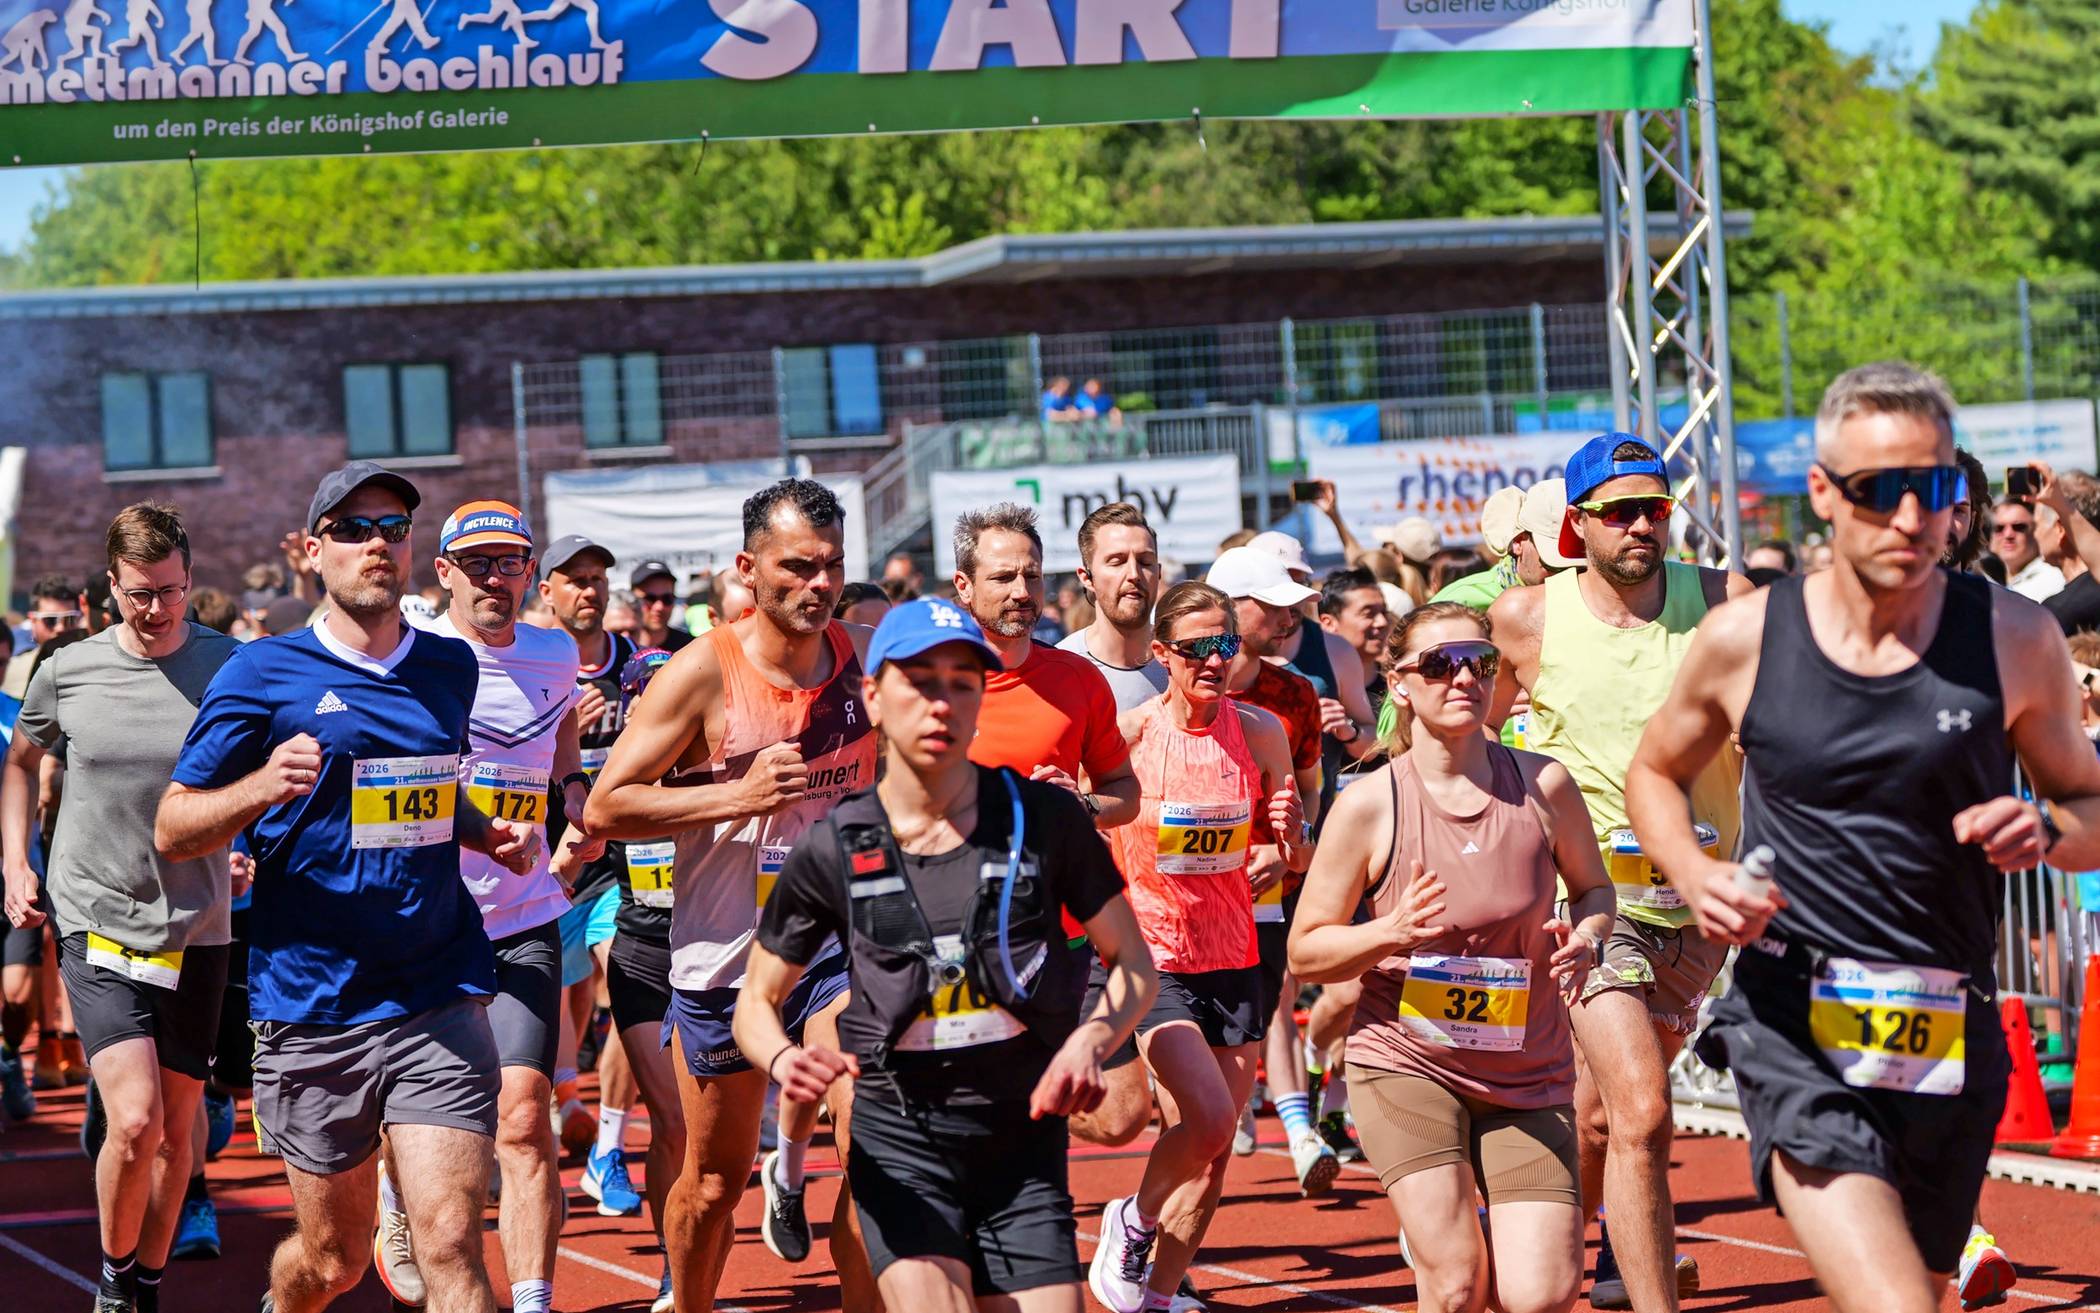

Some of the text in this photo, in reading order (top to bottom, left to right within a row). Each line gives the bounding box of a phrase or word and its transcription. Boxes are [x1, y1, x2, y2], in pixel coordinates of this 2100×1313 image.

[365, 40, 623, 93] bachlauf
[114, 107, 508, 139] um den Preis der Königshof Galerie
[463, 516, 514, 532] INCYLENCE
[315, 703, 348, 715] adidas
[361, 764, 389, 774] 2026
[395, 776, 408, 785] 21.
[479, 766, 502, 777] 2026
[802, 759, 859, 790] unert
[384, 788, 439, 821] 143
[494, 792, 537, 821] 172
[1168, 806, 1192, 816] 2026
[1182, 829, 1234, 854] 207
[1444, 988, 1490, 1023] 32
[1450, 1024, 1478, 1034] Sandra
[1855, 1007, 1931, 1055] 126
